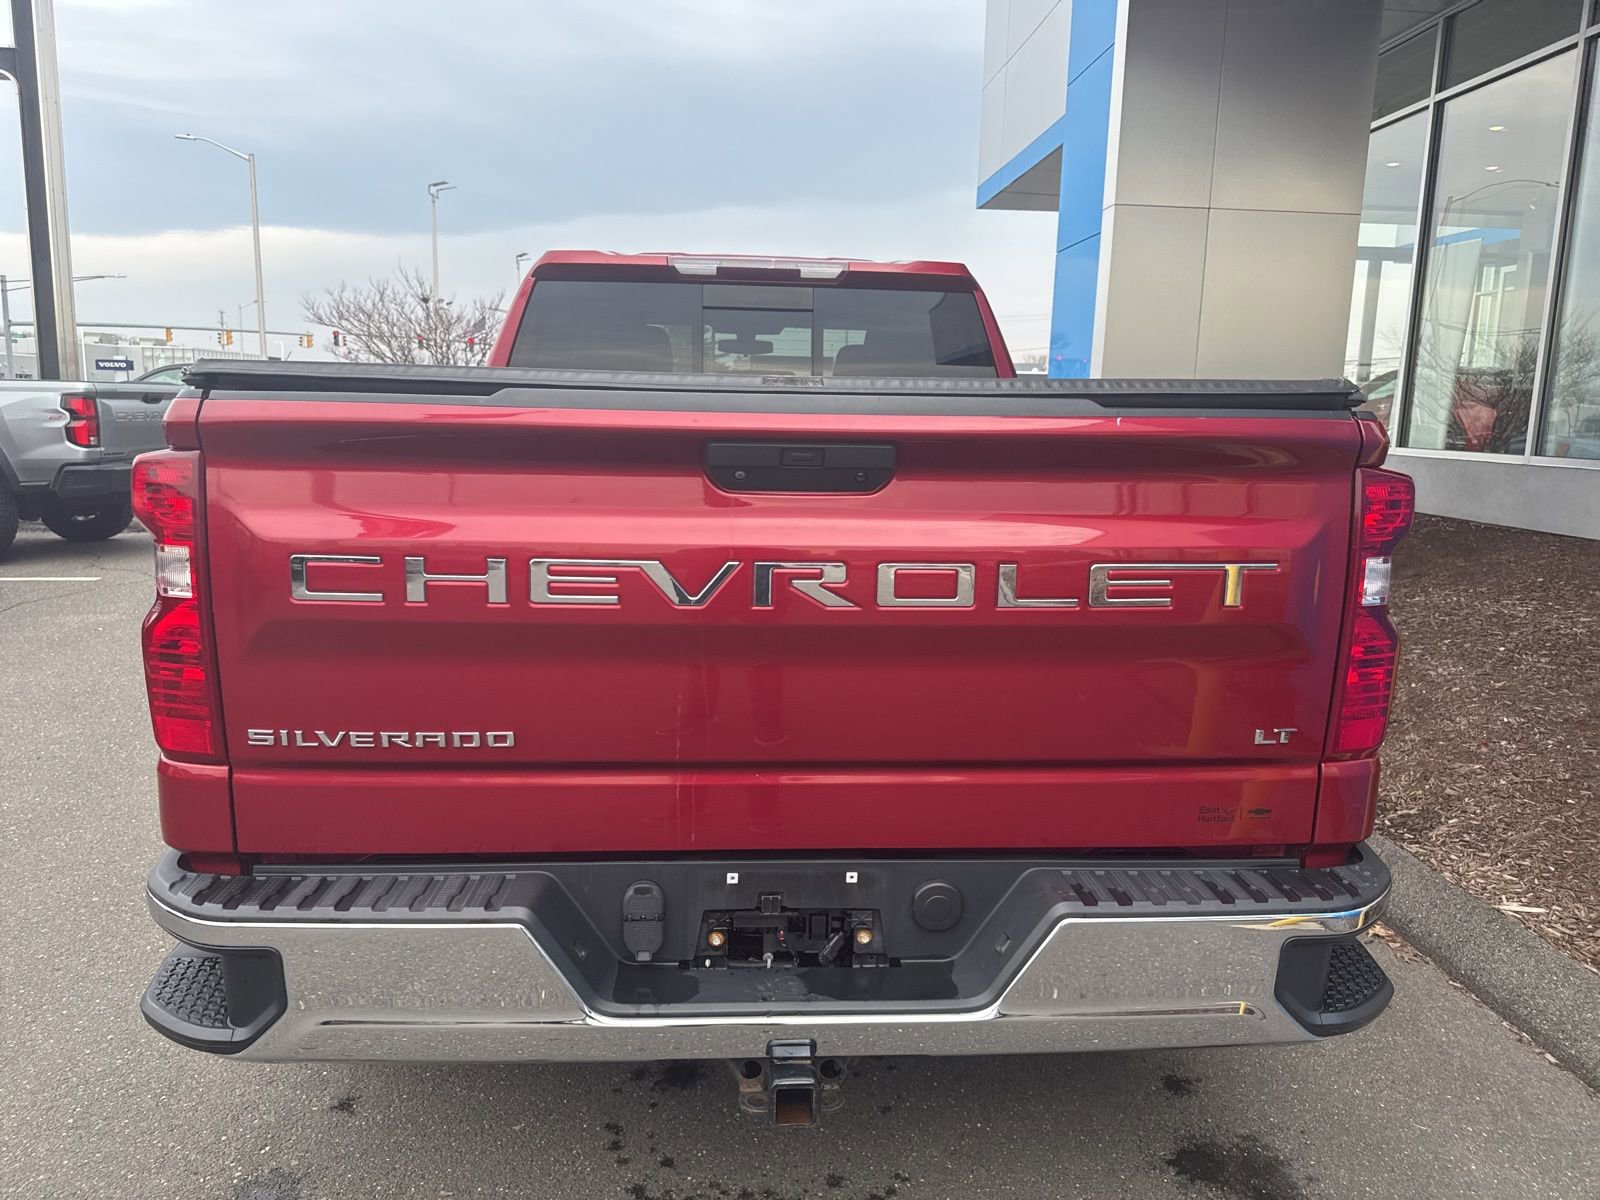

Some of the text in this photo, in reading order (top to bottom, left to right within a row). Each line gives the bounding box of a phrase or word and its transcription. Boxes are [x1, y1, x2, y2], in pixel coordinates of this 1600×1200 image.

[290, 554, 1279, 610] CHEVROLET
[247, 728, 515, 749] SILVERADO
[1254, 728, 1298, 745] LT
[1198, 806, 1220, 814] East
[1198, 814, 1236, 823] Hartford
